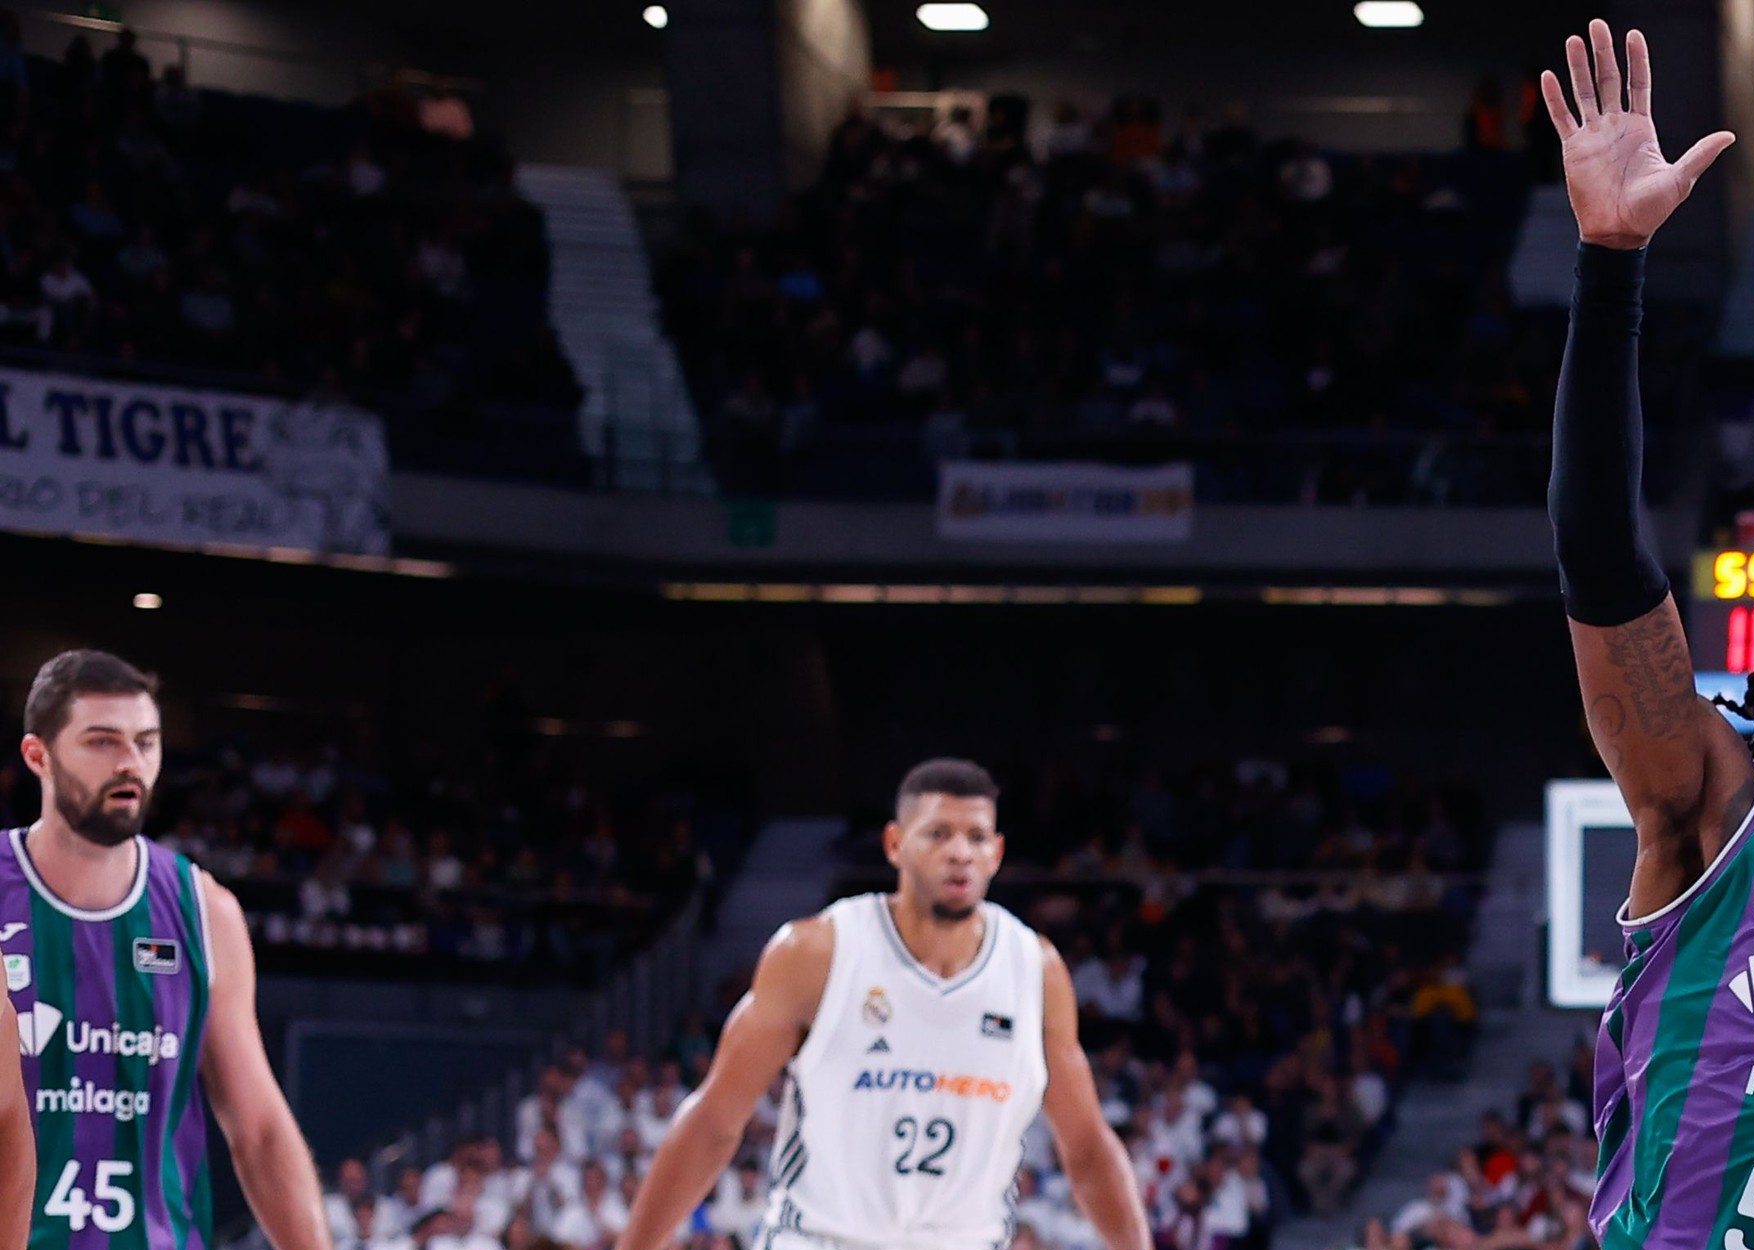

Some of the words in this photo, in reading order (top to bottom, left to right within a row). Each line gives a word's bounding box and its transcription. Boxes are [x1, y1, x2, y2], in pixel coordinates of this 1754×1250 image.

[46, 390, 264, 473] TIGRE
[66, 1020, 180, 1066] Unicaja
[854, 1070, 1012, 1104] AUTOHERO
[894, 1117, 955, 1176] 22
[44, 1159, 135, 1232] 45
